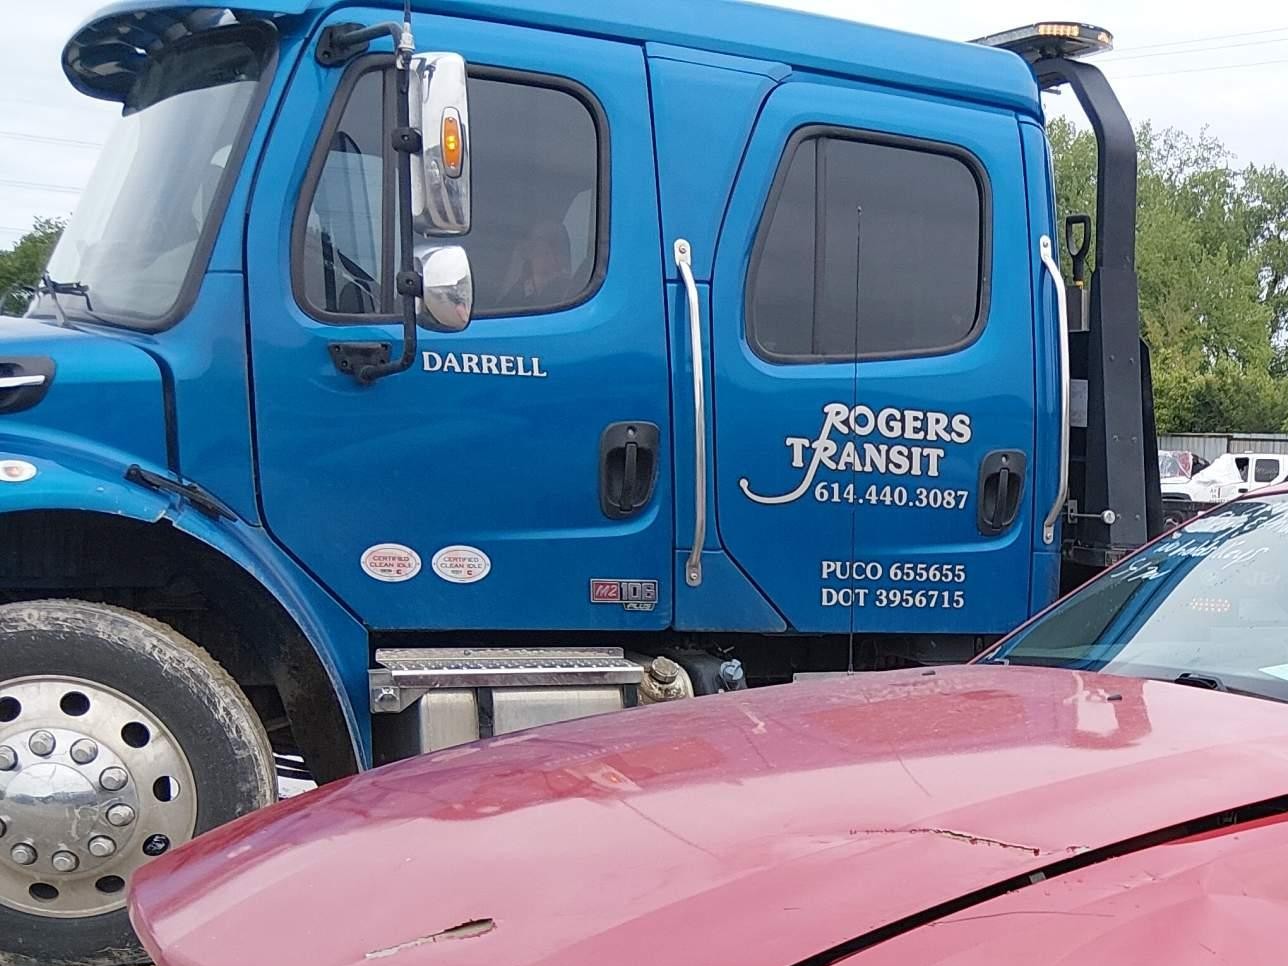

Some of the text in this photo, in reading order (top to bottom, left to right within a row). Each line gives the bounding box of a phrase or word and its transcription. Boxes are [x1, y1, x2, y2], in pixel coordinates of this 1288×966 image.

[422, 351, 548, 378] DARRELL
[823, 402, 973, 444] ROGERS
[785, 436, 945, 477] TRANSIT
[814, 481, 969, 510] 614.440.3087
[821, 560, 966, 583] PUCO 655655
[595, 582, 656, 601] M2 106
[821, 588, 965, 608] DOT 3956715
